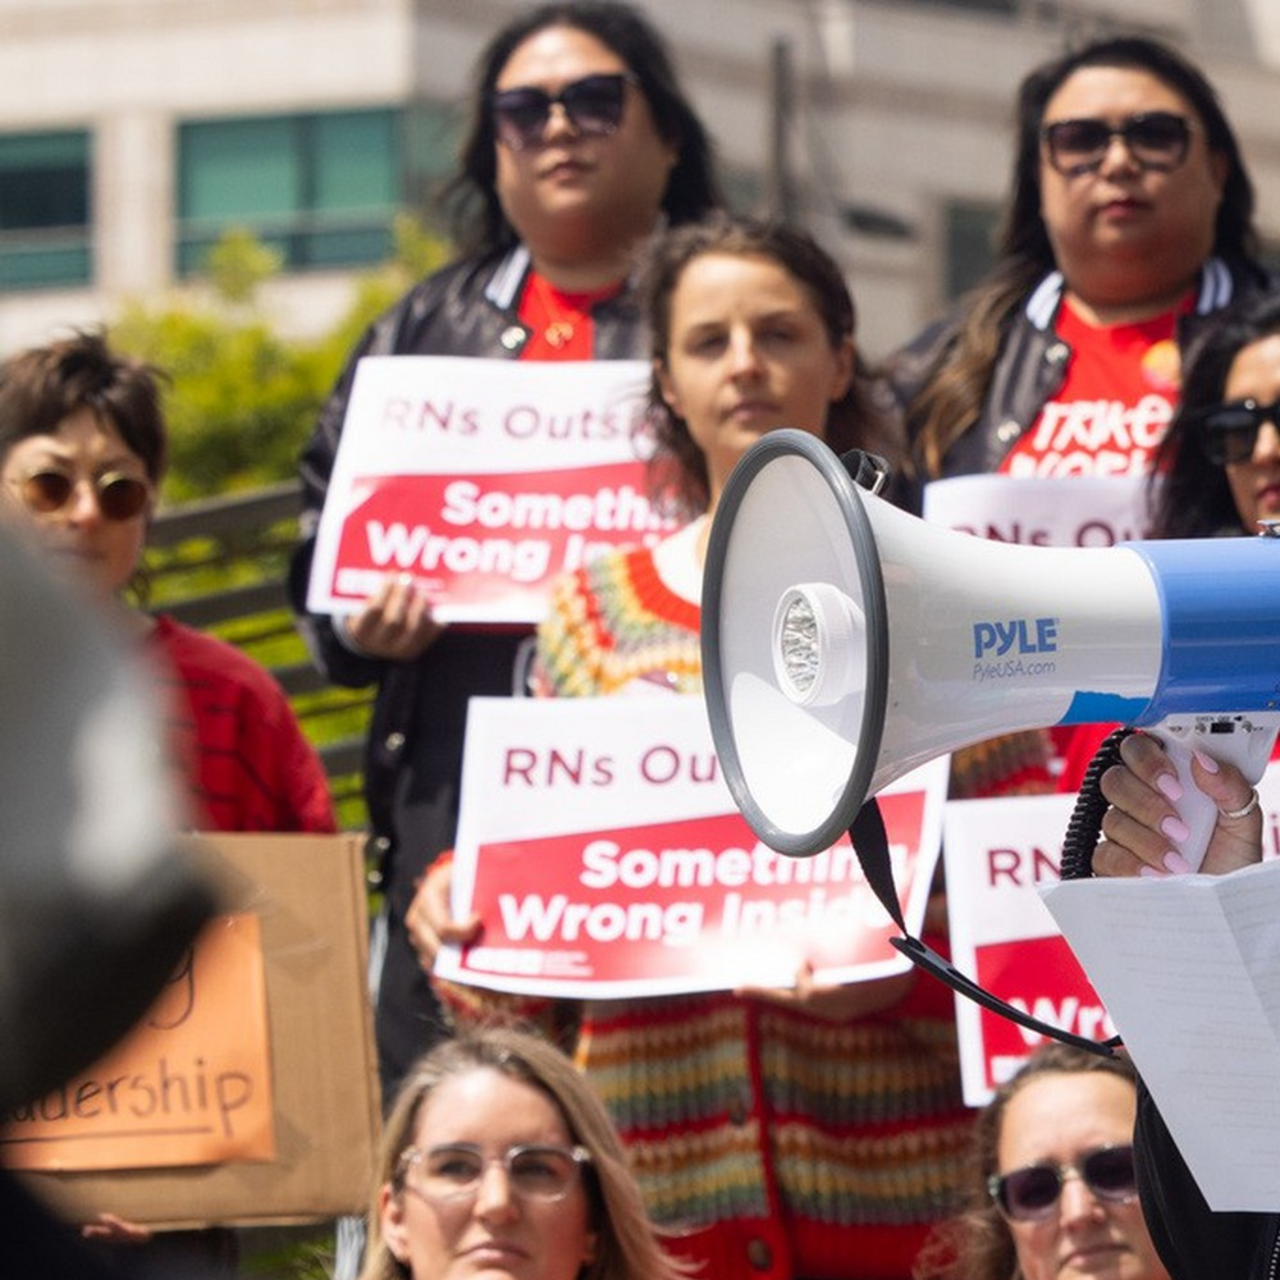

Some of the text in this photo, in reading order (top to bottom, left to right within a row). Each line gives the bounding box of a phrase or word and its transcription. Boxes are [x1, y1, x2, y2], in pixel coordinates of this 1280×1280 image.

[366, 519, 551, 584] Wrong
[502, 747, 615, 788] RNs
[987, 849, 1062, 887] RN
[498, 893, 703, 947] Wrong
